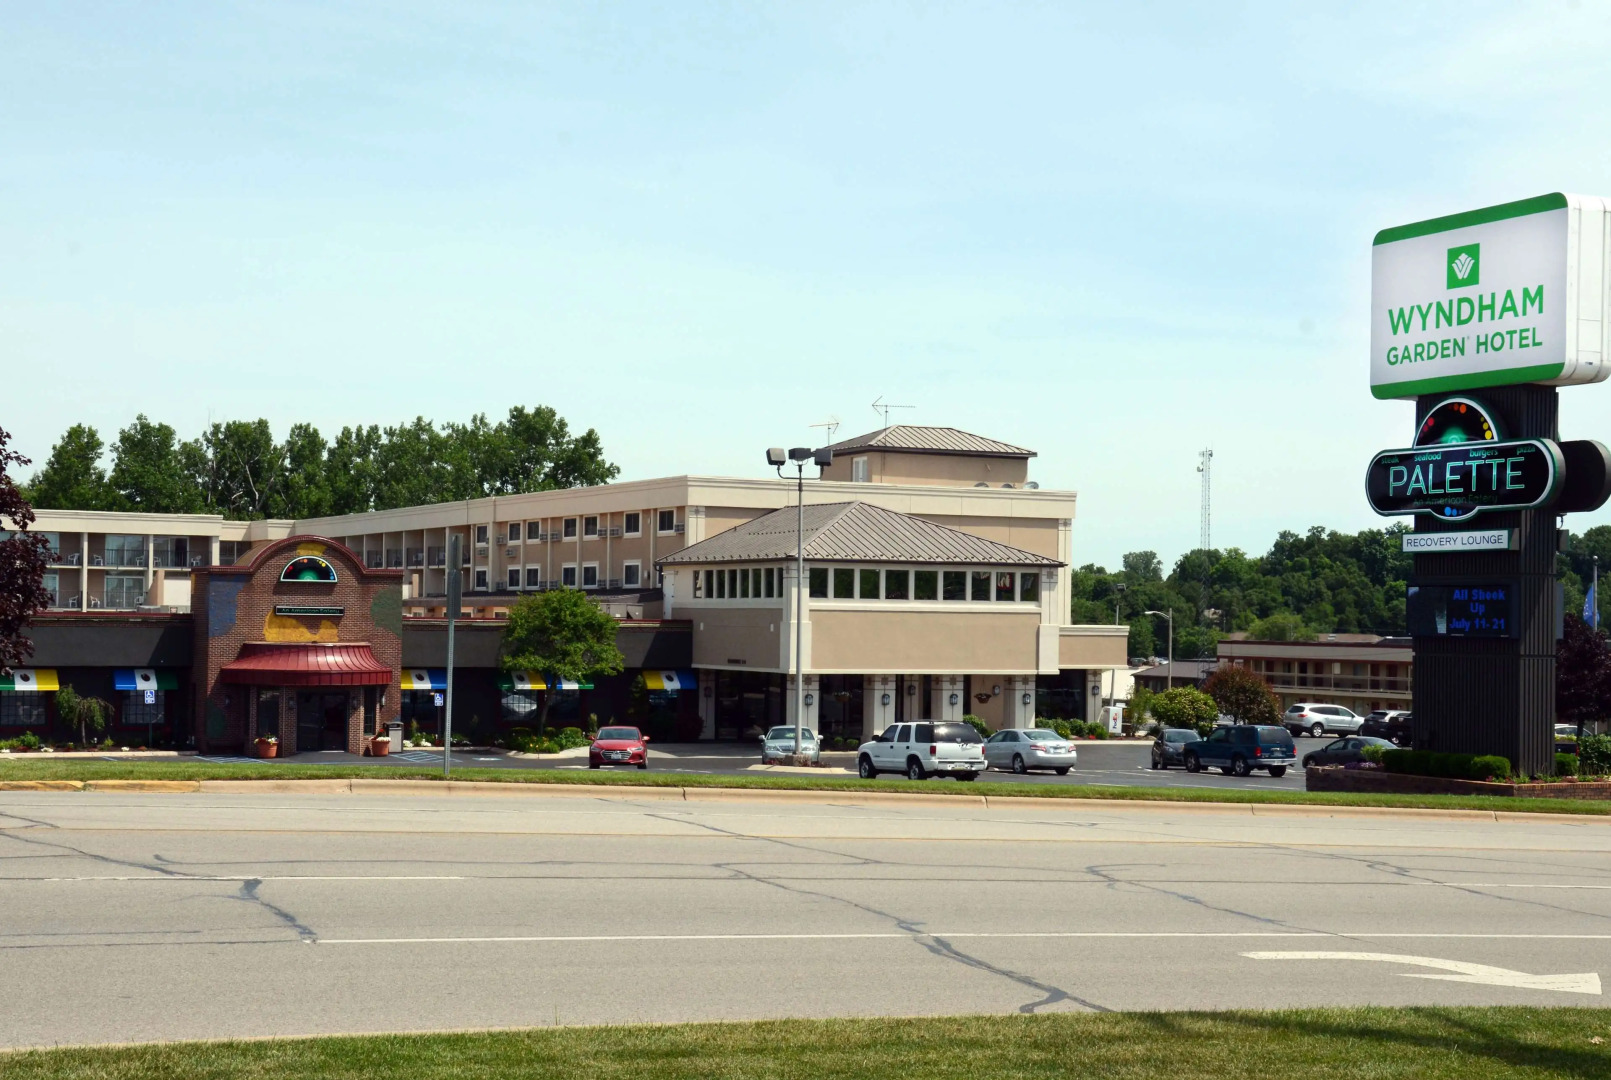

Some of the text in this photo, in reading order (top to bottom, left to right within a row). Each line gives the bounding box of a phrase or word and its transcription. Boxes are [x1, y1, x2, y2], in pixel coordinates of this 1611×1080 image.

[1388, 284, 1544, 336] WYNDHAM
[1386, 326, 1543, 366] GARDEN HOTEL
[1381, 445, 1536, 465] steak seafood burgers pizza
[1389, 456, 1525, 497] PALETTE
[1426, 496, 1467, 506] American
[1468, 494, 1499, 504] Eatery
[1406, 534, 1504, 547] RECOVERY LOUNGE
[1453, 588, 1469, 601] All
[1470, 602, 1486, 616] Up
[1450, 617, 1471, 632] July
